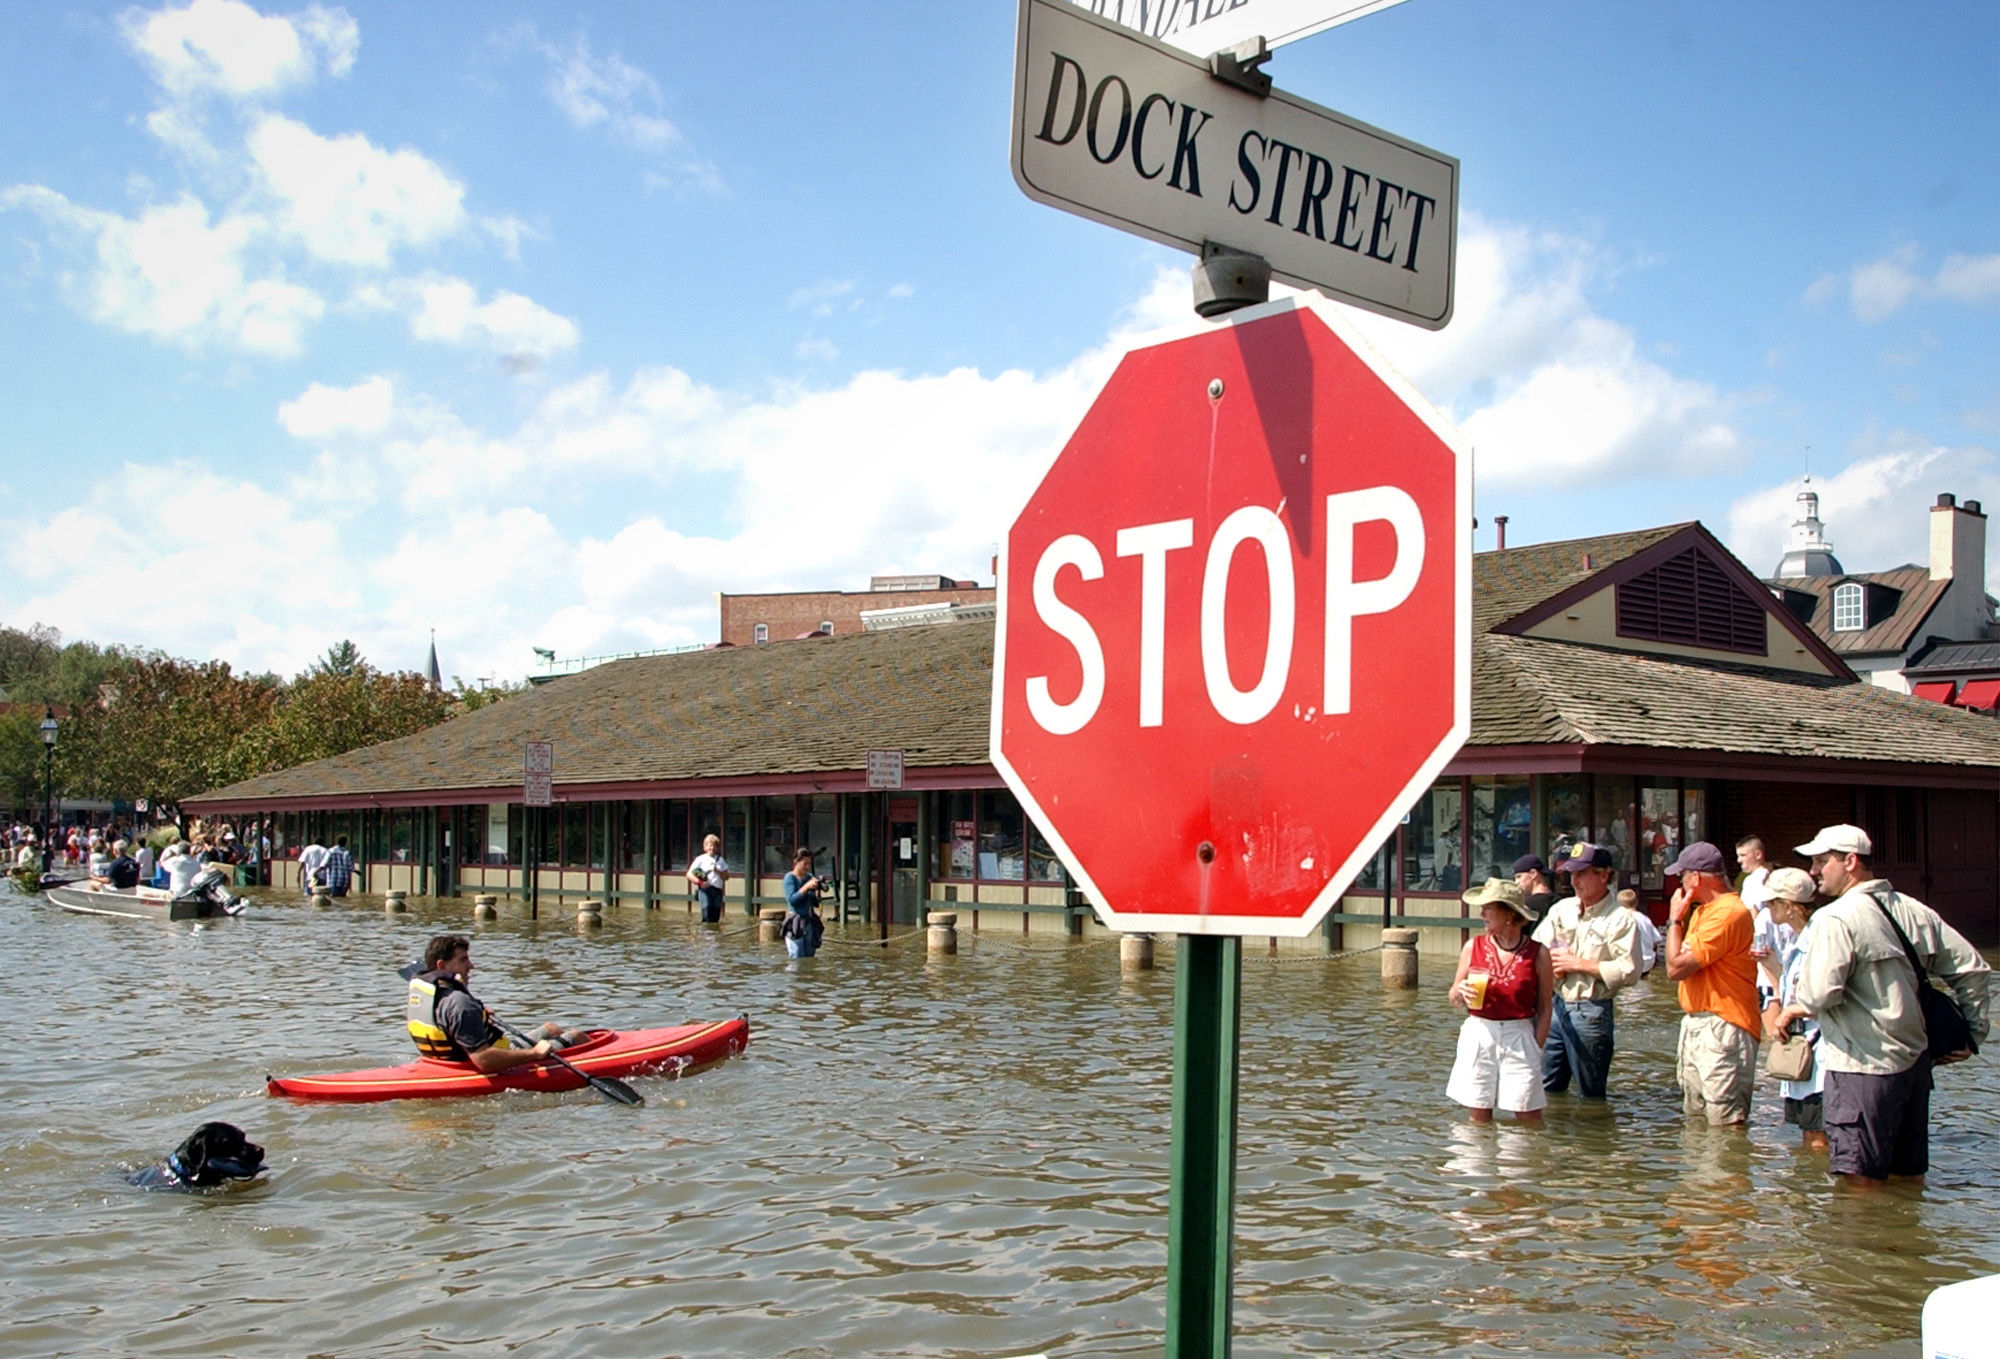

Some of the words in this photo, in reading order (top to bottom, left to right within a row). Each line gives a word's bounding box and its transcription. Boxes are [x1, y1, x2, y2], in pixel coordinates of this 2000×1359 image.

[1034, 51, 1214, 199] DOCK
[1227, 129, 1436, 273] STREET
[1025, 485, 1426, 736] STOP
